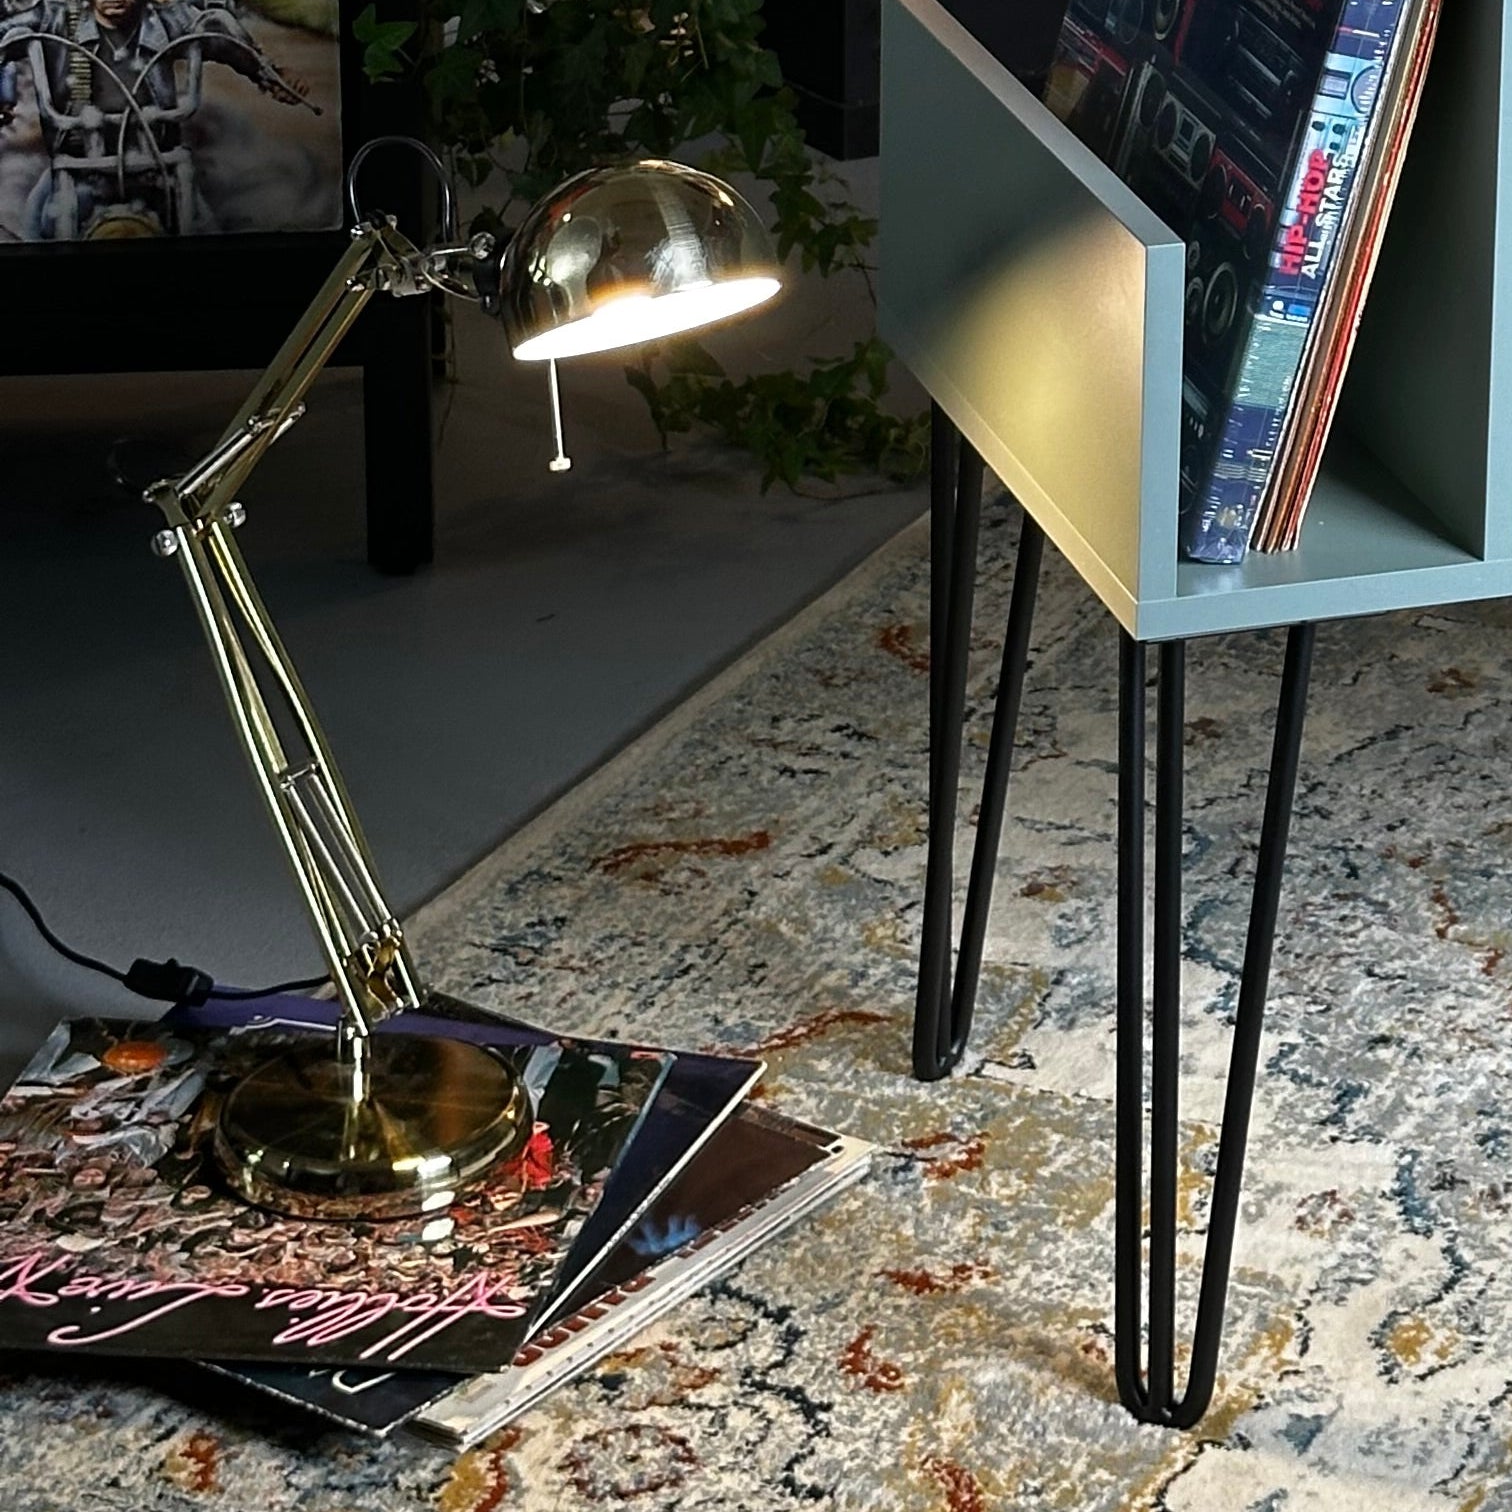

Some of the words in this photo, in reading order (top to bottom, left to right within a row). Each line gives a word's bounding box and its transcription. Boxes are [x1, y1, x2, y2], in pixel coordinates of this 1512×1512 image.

[1279, 149, 1328, 275] HIP-HOP
[1301, 229, 1327, 280] ALL
[1315, 152, 1350, 228] STARS
[45, 1276, 251, 1346] Live
